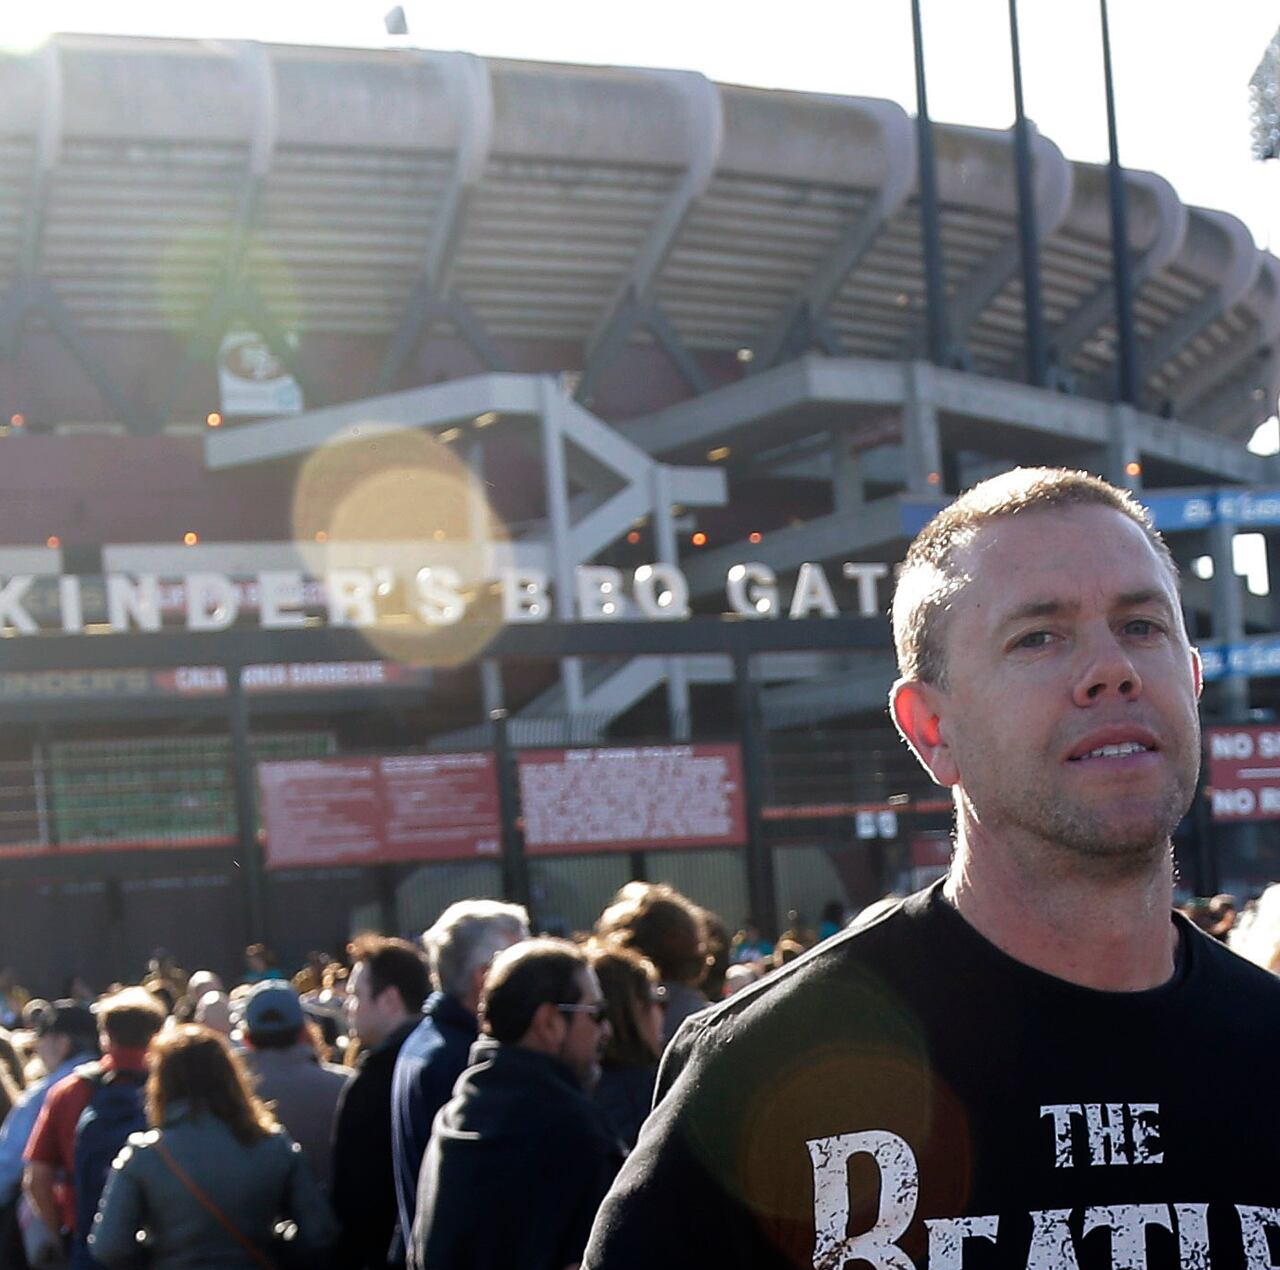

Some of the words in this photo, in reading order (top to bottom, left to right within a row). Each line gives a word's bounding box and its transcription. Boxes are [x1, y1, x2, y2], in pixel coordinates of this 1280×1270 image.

[500, 561, 691, 623] BBQ
[727, 561, 900, 620] GAT
[1211, 732, 1255, 760] NO
[1211, 787, 1257, 815] NO
[1040, 1102, 1164, 1168] THE
